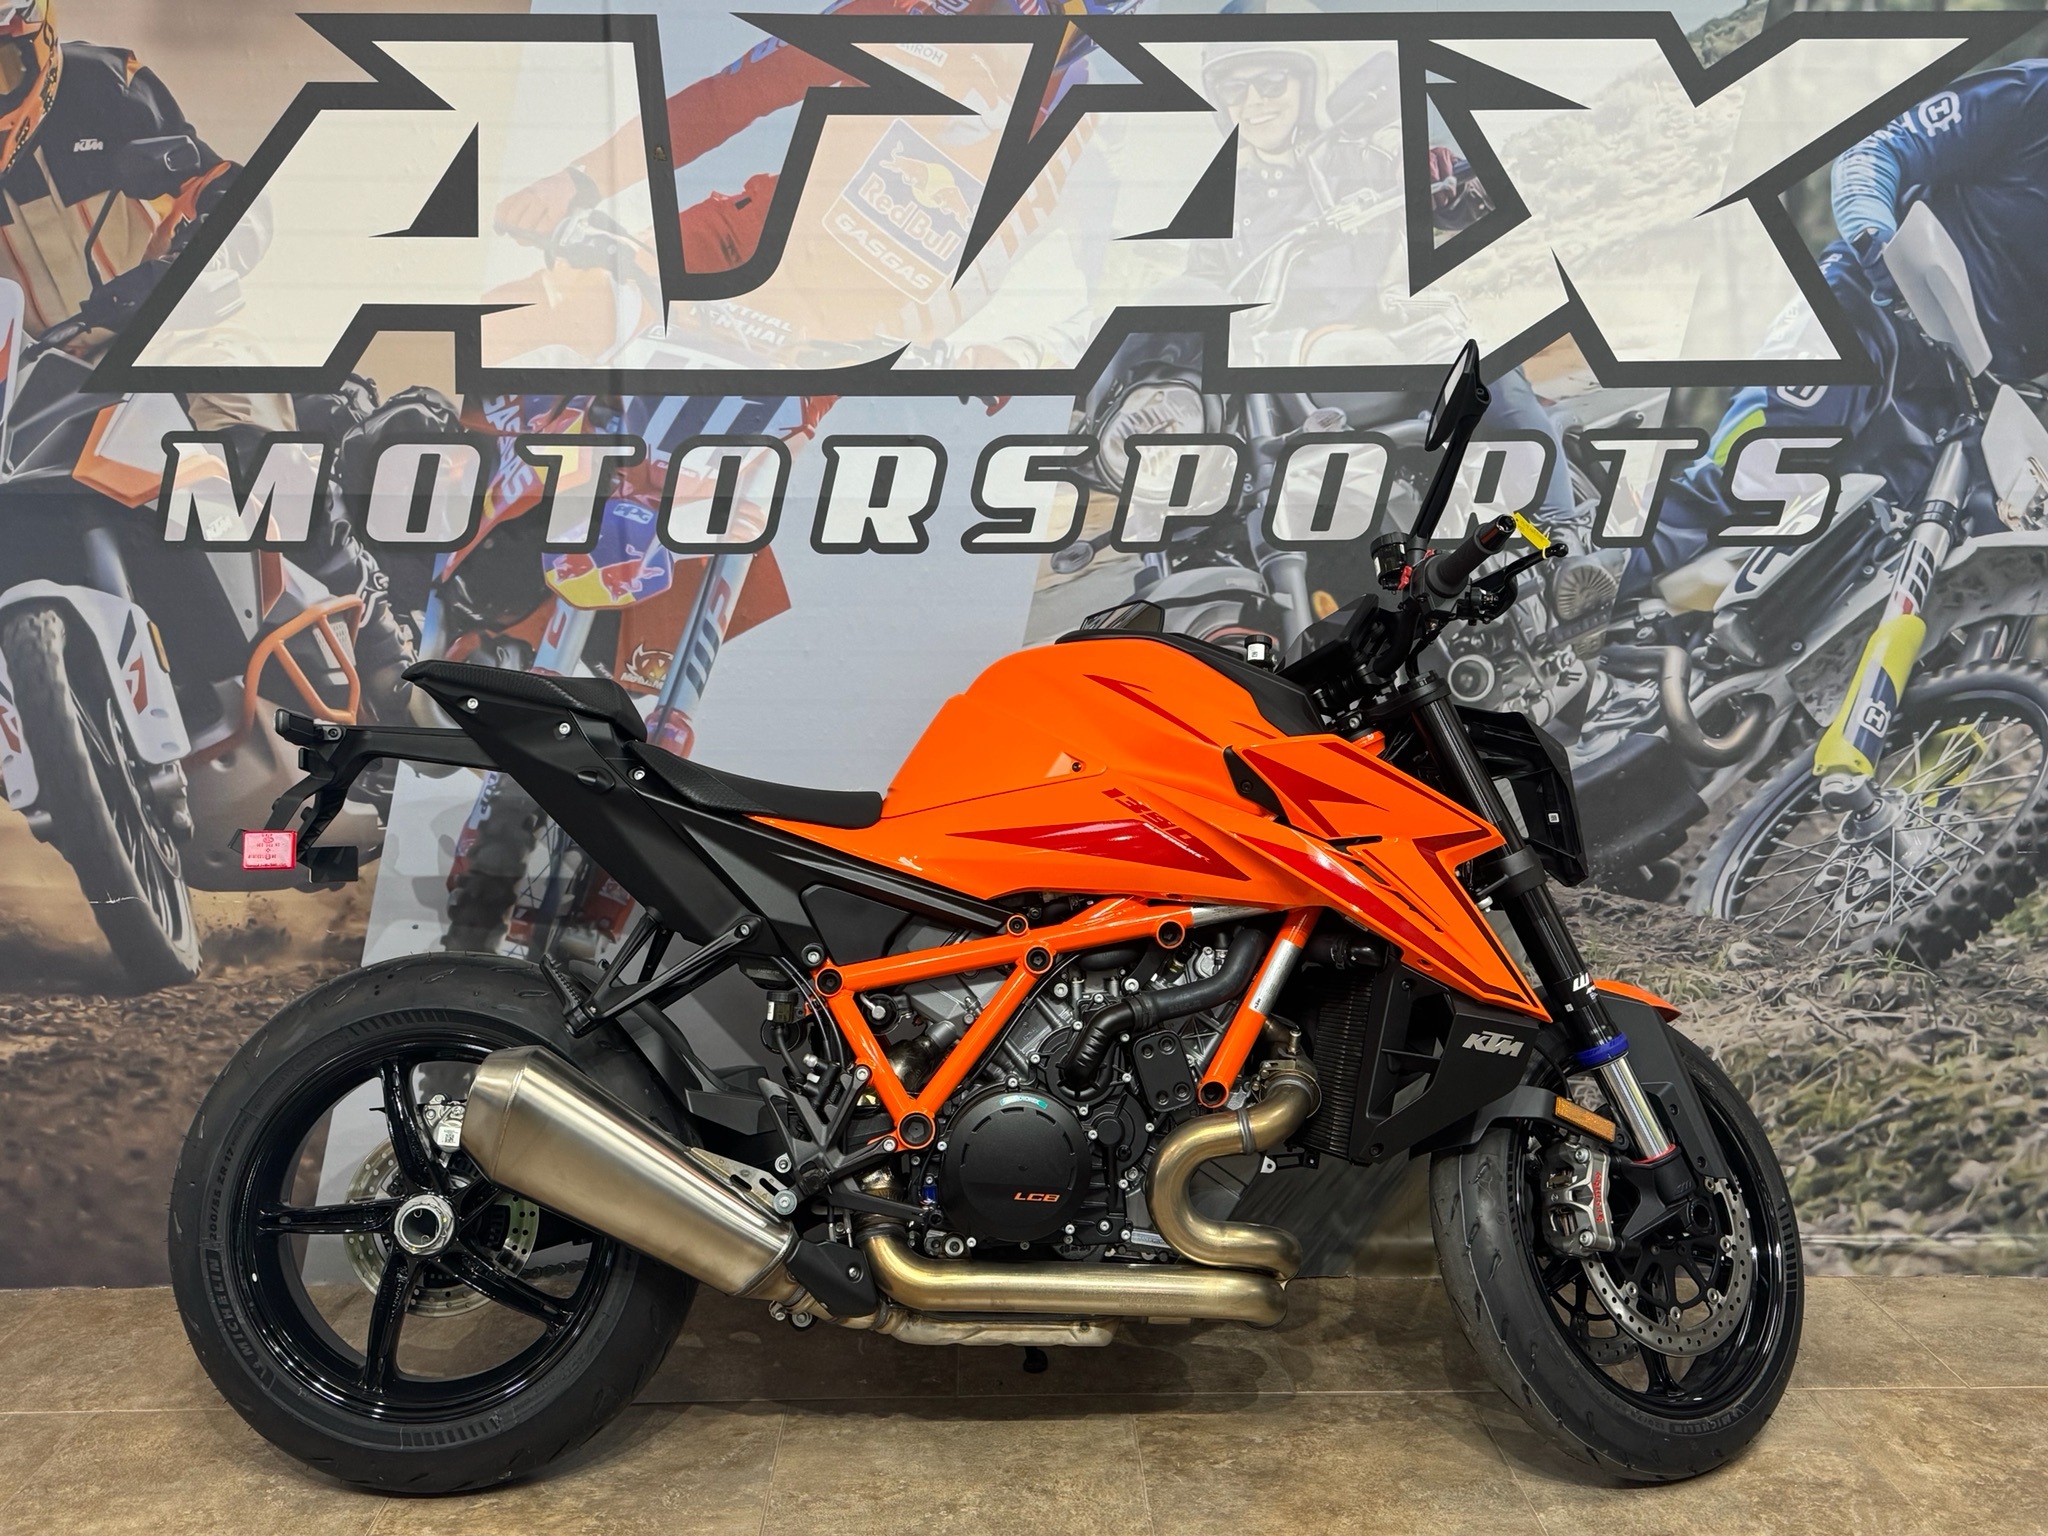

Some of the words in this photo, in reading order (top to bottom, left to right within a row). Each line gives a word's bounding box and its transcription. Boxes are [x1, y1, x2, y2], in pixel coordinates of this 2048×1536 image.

[73, 138, 104, 153] KTM
[82, 11, 2046, 394] AJAX
[835, 213, 932, 290] GASGAS
[161, 431, 1849, 553] MOTORSPORTS
[1462, 1030, 1524, 1057] KTM
[1013, 1192, 1060, 1202] LC8
[1592, 1171, 1605, 1223] brembo
[208, 1258, 254, 1356] MICHELIN
